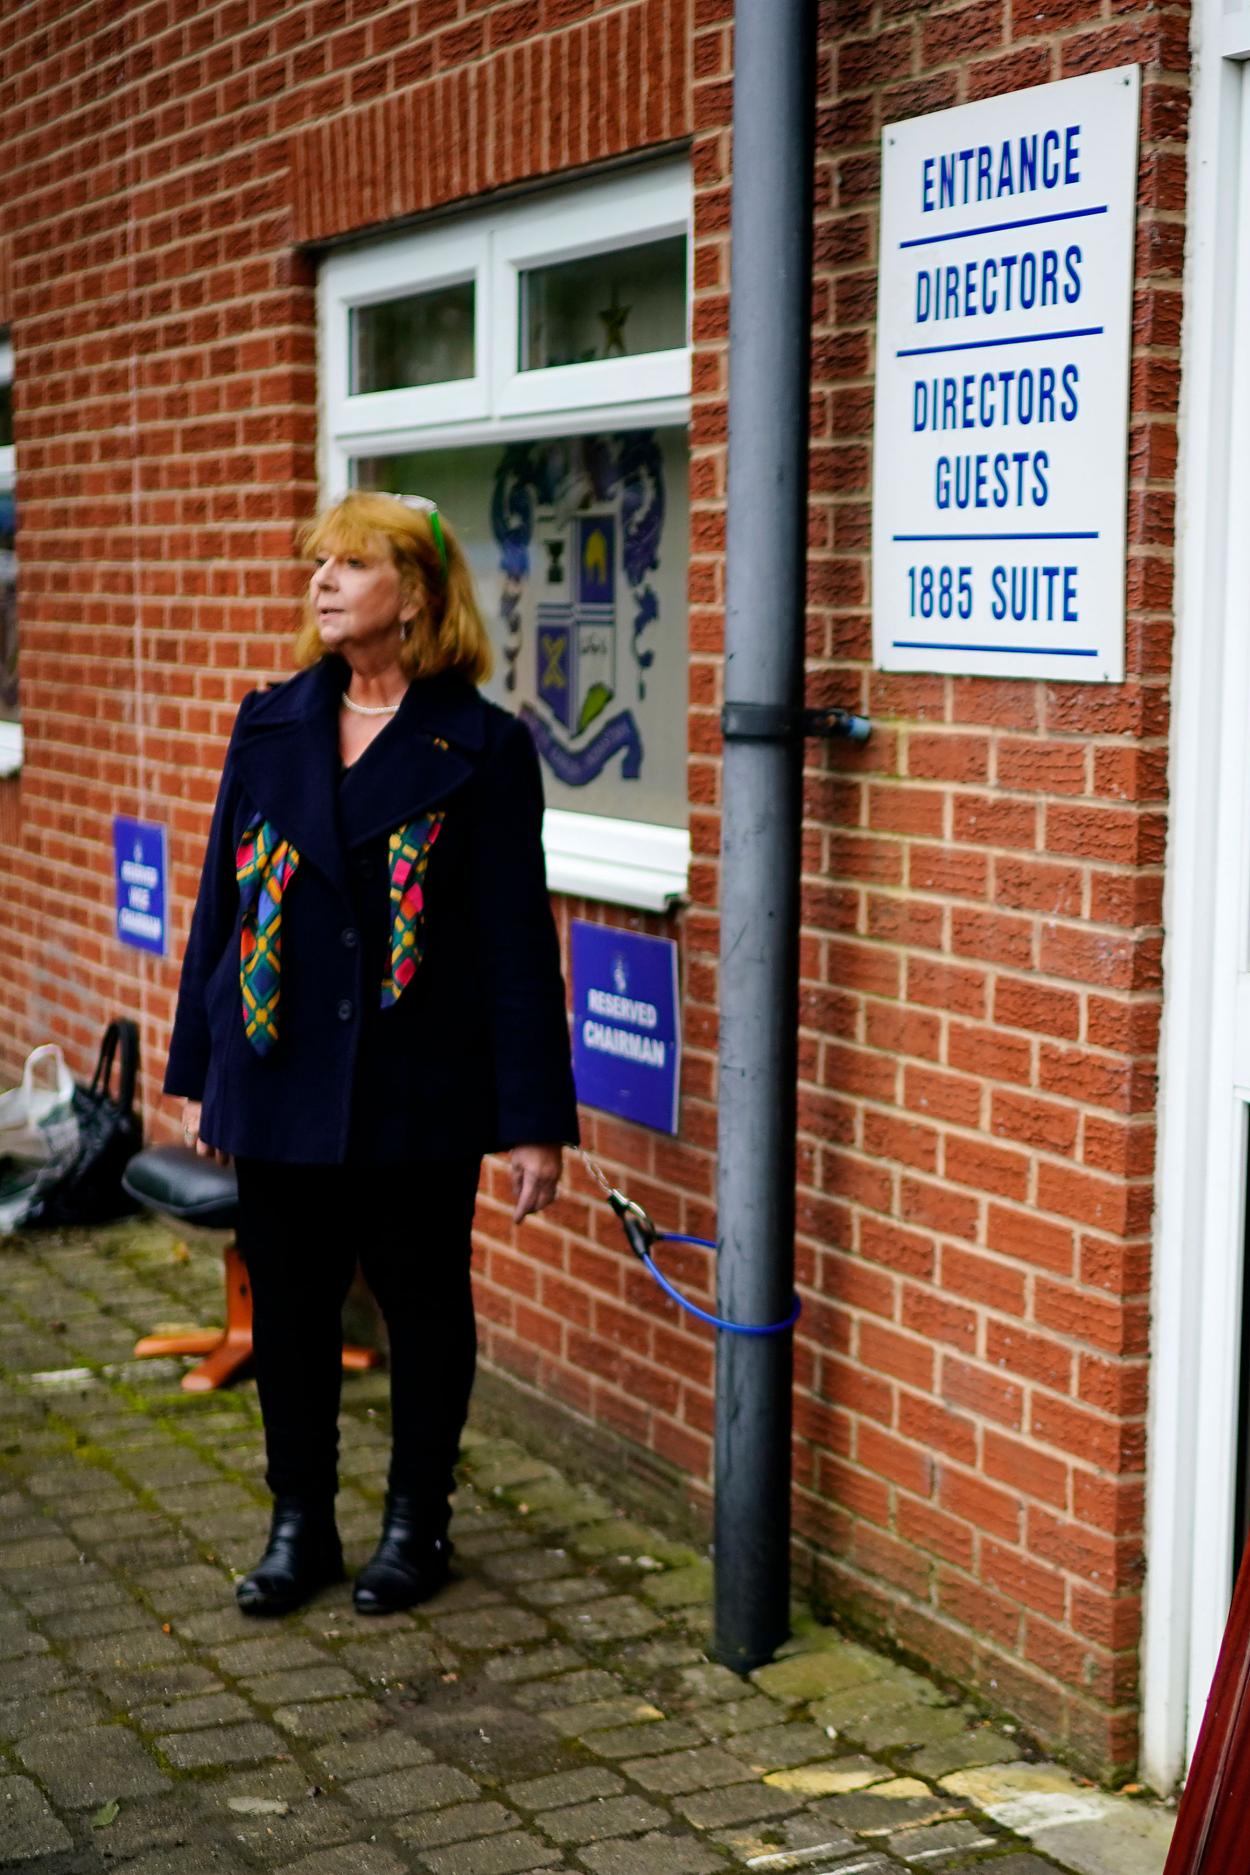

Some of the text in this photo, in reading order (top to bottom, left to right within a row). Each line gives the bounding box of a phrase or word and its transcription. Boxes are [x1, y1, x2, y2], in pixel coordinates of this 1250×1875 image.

[922, 125, 1081, 213] ENTRANCE
[915, 244, 1083, 324] DIRECTORS
[912, 363, 1079, 432] DIRECTORS
[935, 450, 1050, 510] GUESTS
[907, 565, 1079, 623] 1885 SUITE
[587, 988, 657, 1030] RESERVED
[582, 1019, 665, 1068] CHAIRMAN
